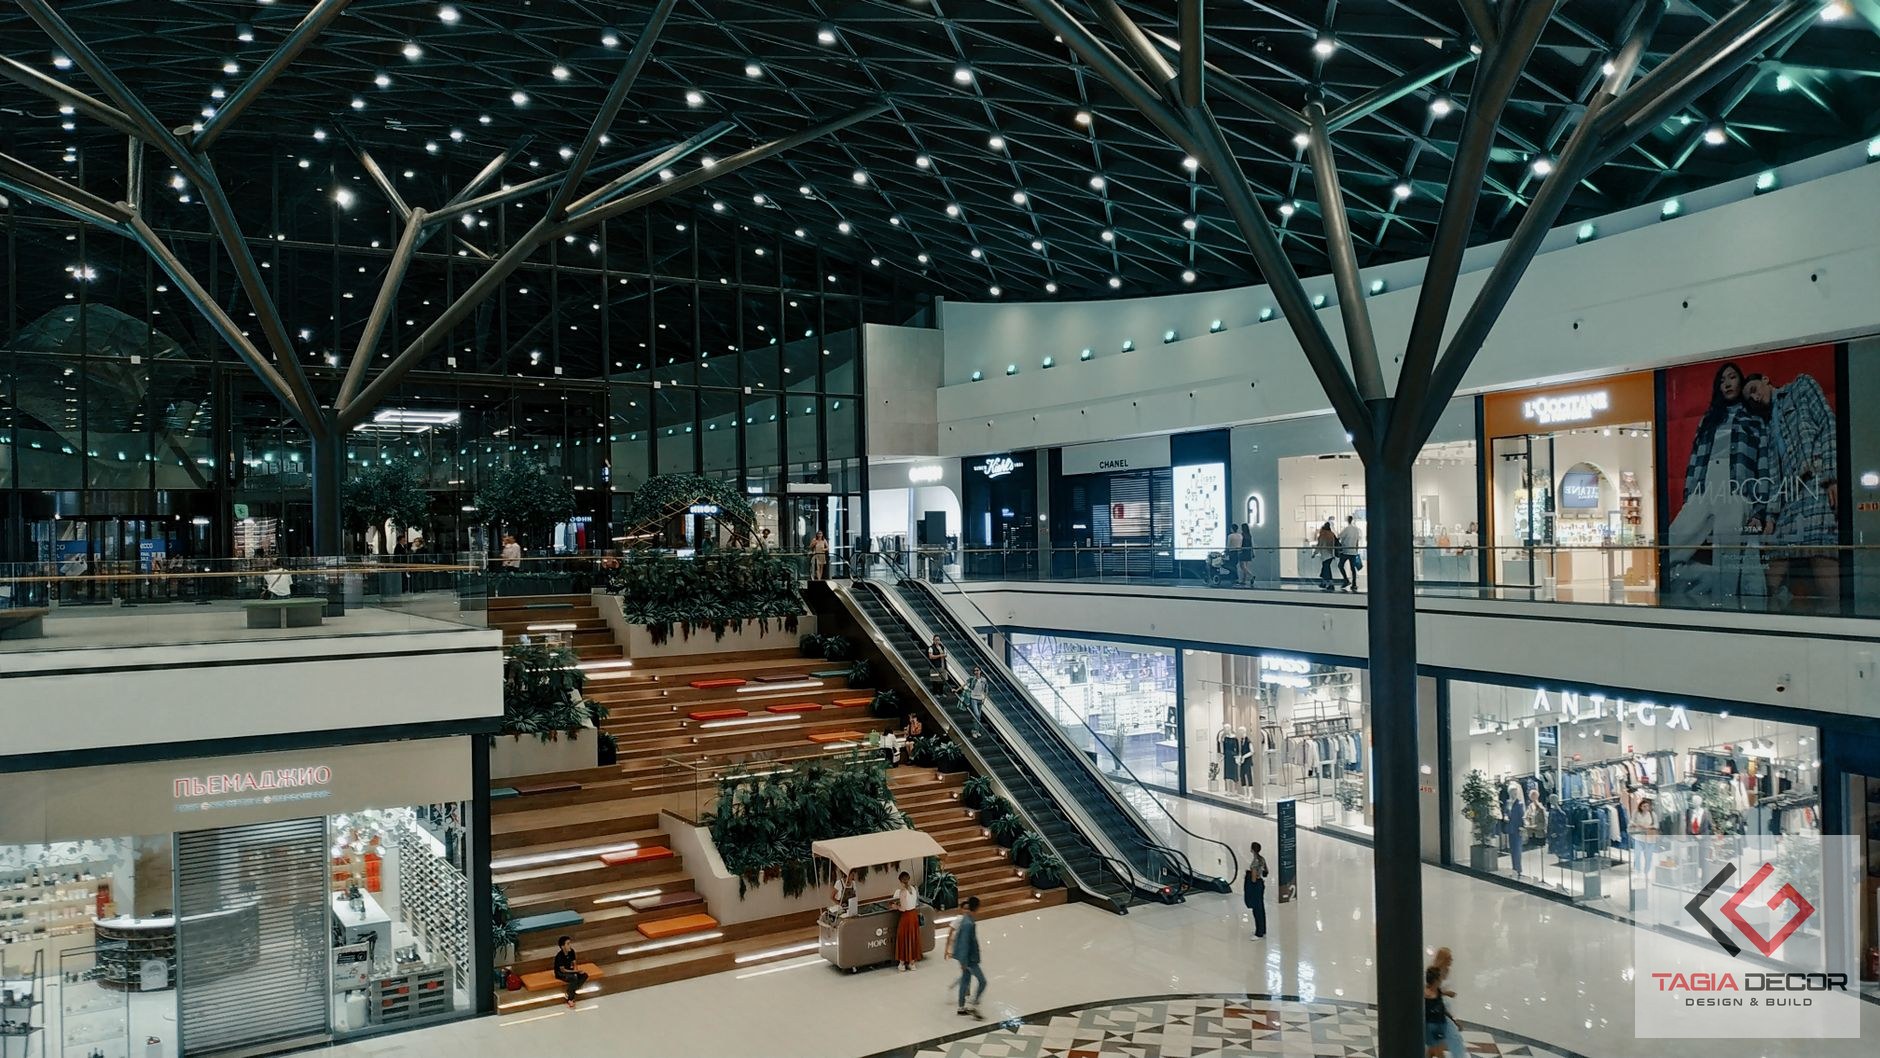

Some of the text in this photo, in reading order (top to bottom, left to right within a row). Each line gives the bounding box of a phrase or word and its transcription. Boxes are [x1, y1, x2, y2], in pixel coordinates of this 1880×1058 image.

[983, 457, 1014, 478] Kiehl's
[1099, 459, 1129, 469] CHANEL
[1533, 688, 1691, 731] ANTIGA
[173, 765, 333, 798] ПЬЕМАДЖИО
